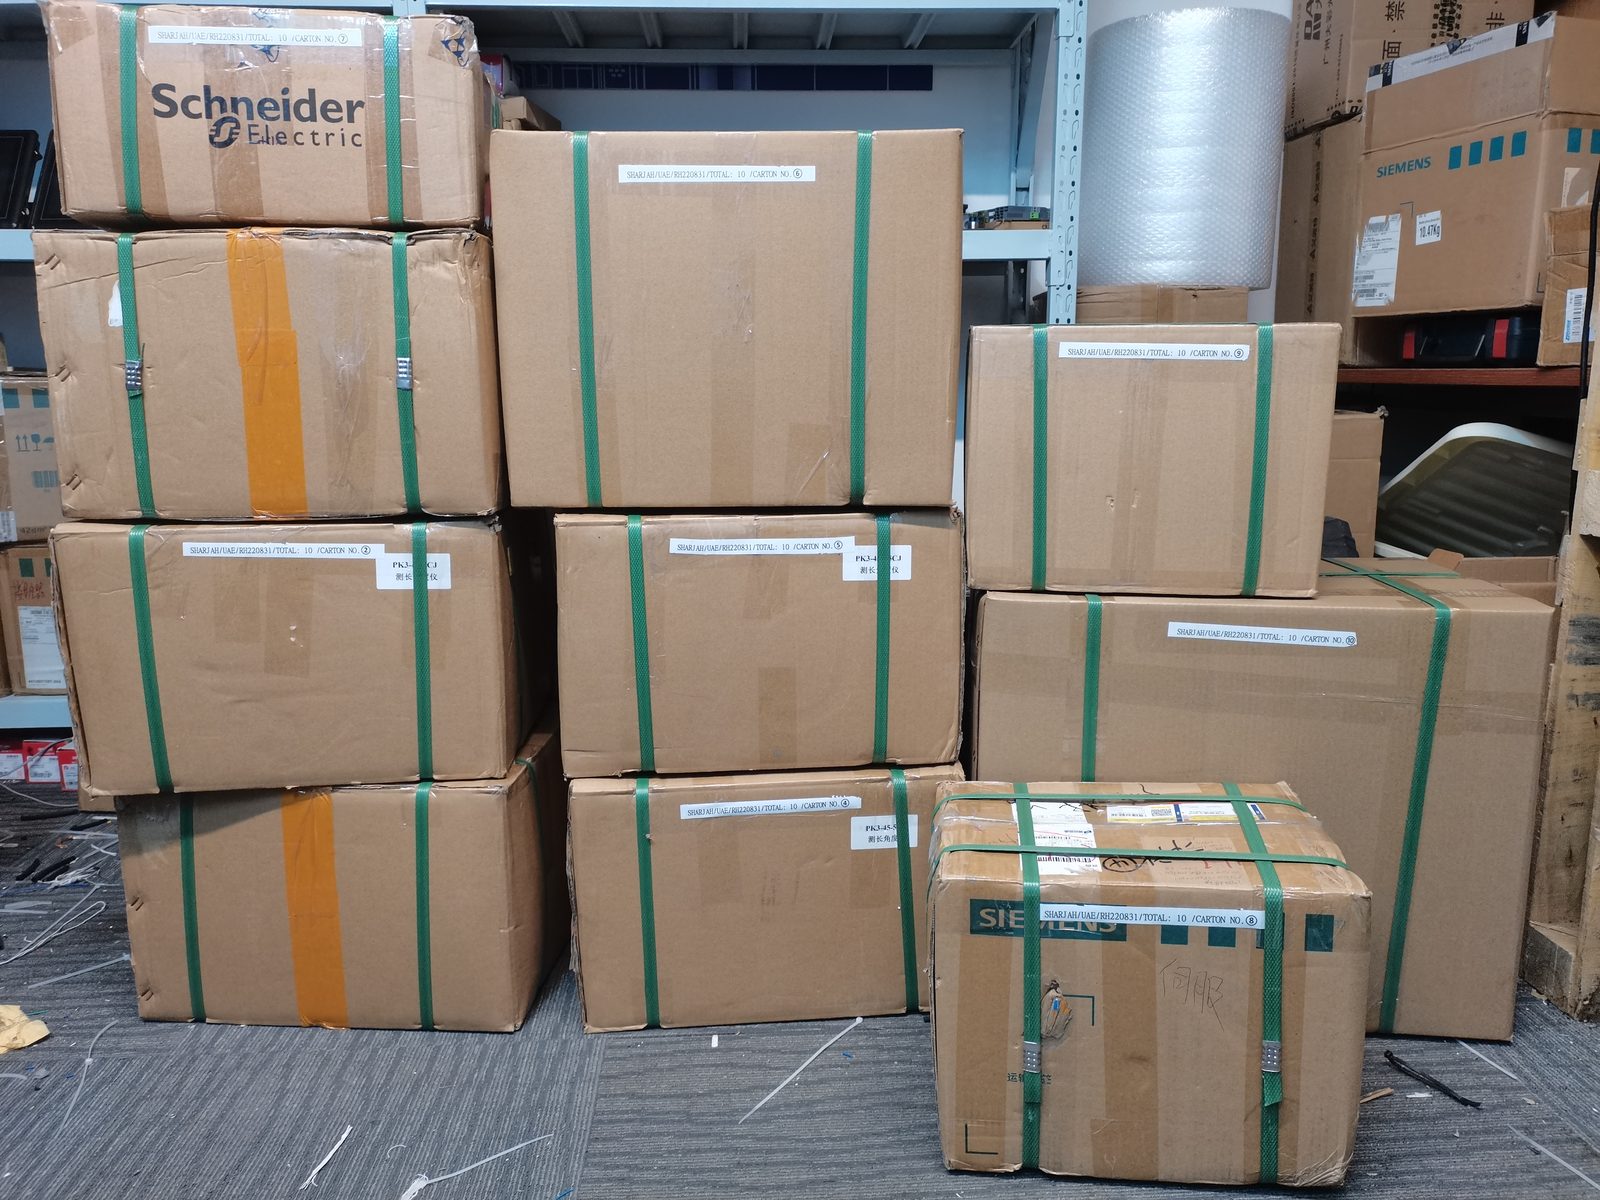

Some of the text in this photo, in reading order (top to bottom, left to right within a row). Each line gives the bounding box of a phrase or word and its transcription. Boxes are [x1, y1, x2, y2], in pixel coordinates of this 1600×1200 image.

[292, 34, 321, 43] /CARTON
[151, 83, 365, 123] Schneider
[248, 124, 363, 147] Electric
[1376, 156, 1431, 178] SIEMENS
[749, 170, 777, 178] /CARTON
[1190, 349, 1218, 357] /CARTON
[316, 546, 345, 554] /CARTON
[792, 542, 820, 551] /CARTON
[860, 566, 899, 574] 测长仪
[395, 572, 438, 581] 测长仪
[1288, 634, 1297, 642] 10
[1300, 635, 1330, 643] /CARTON
[801, 801, 826, 810] /CARTON
[1044, 910, 1171, 923] SHARJAH/UAE/RH220831/TOTAL:
[1177, 914, 1187, 923] 10
[1191, 914, 1226, 924] /CARTON
